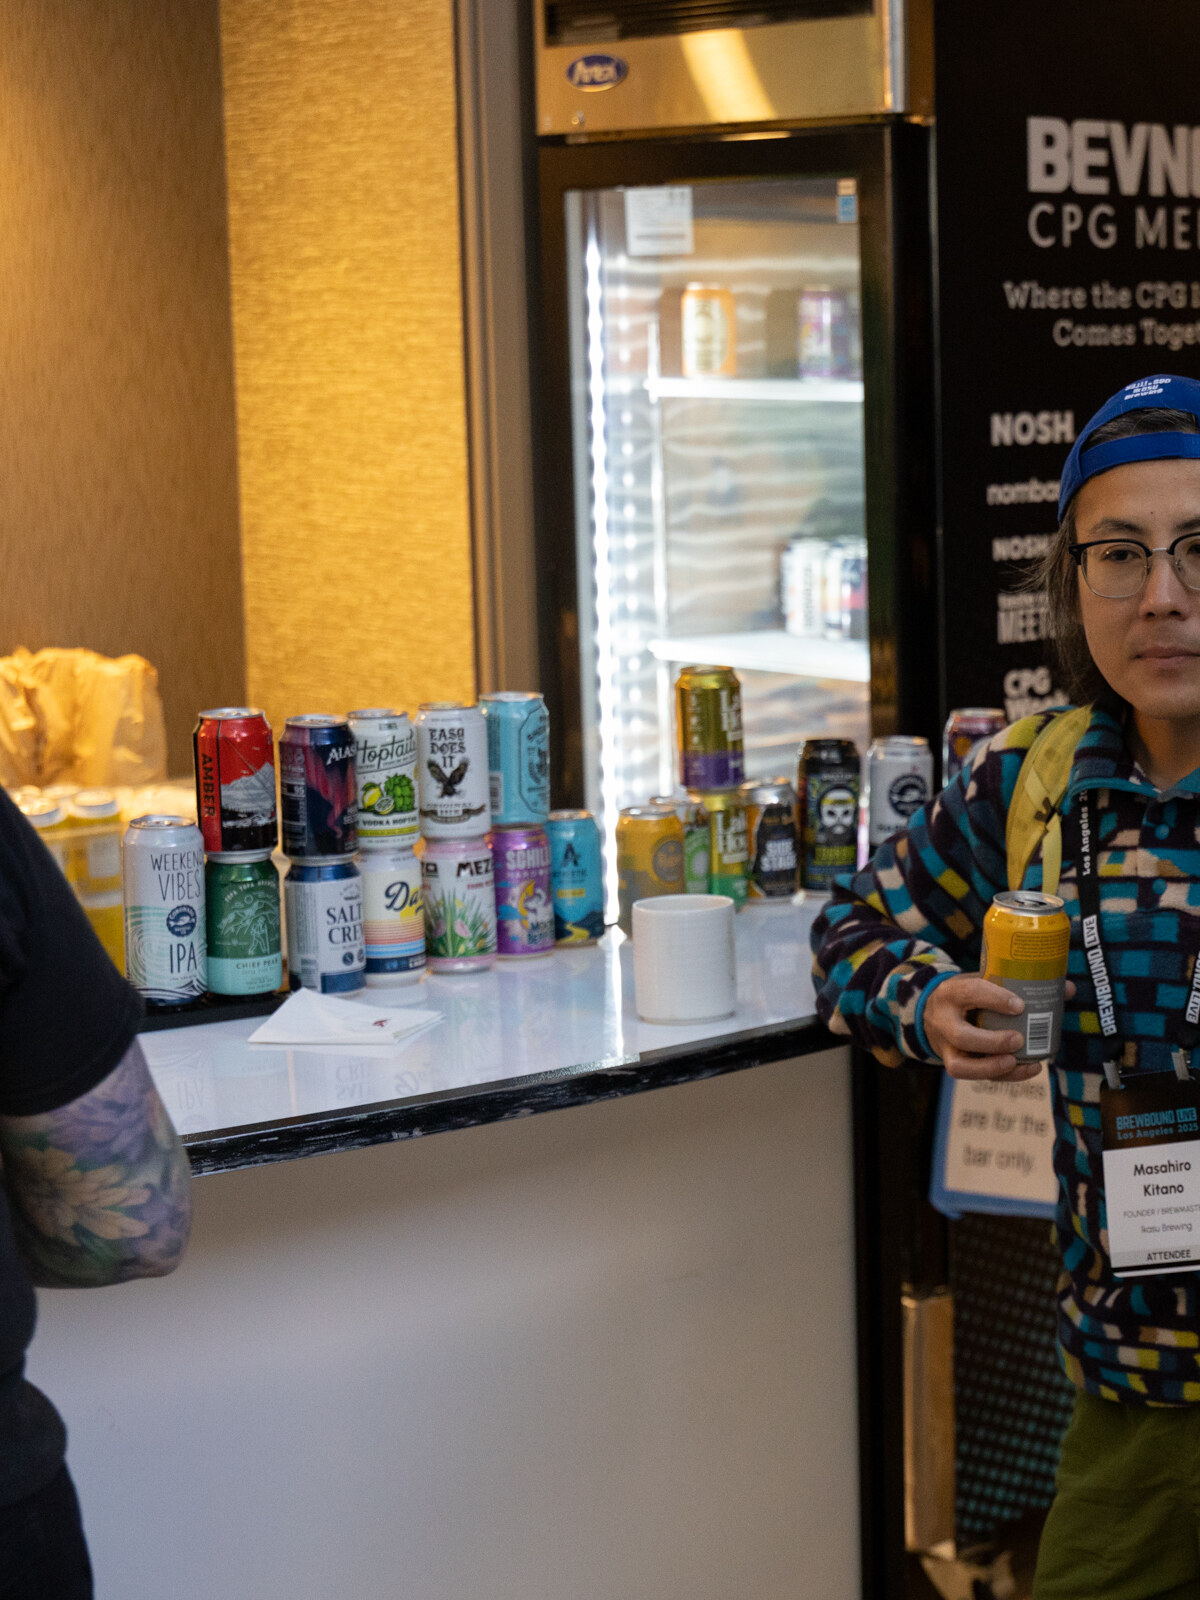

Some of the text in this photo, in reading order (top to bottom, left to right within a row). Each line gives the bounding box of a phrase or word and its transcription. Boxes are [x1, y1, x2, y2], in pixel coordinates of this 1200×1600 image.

[1027, 202, 1118, 249] CPG
[1003, 280, 1087, 309] Where
[1091, 280, 1132, 308] the
[1136, 282, 1187, 309] CPG
[1052, 319, 1136, 347] Comes
[990, 410, 1075, 446] NOSH
[1004, 666, 1051, 699] CPG
[430, 742, 466, 754] DOES
[443, 756, 455, 769] IT
[201, 752, 216, 817] AMBER
[1079, 806, 1091, 853] Angeles
[1082, 857, 1091, 876] Los
[158, 869, 201, 902] VIBES
[384, 881, 424, 916] Da
[328, 923, 364, 945] CRE
[1083, 915, 1099, 948] LIVE
[169, 941, 198, 974] IPA
[960, 1109, 1049, 1138] are for the
[1116, 1107, 1198, 1130] BREWBOUND LIVE
[1117, 1123, 1198, 1140] Los Angeles 2025
[963, 1145, 1035, 1176] bar only
[1133, 1160, 1191, 1176] Masahiro
[1143, 1183, 1184, 1197] Kitano
[1123, 1207, 1155, 1218] FOUNDER
[1141, 1222, 1193, 1233] Ikasu Brewing
[1147, 1249, 1191, 1261] ATTENDEE
